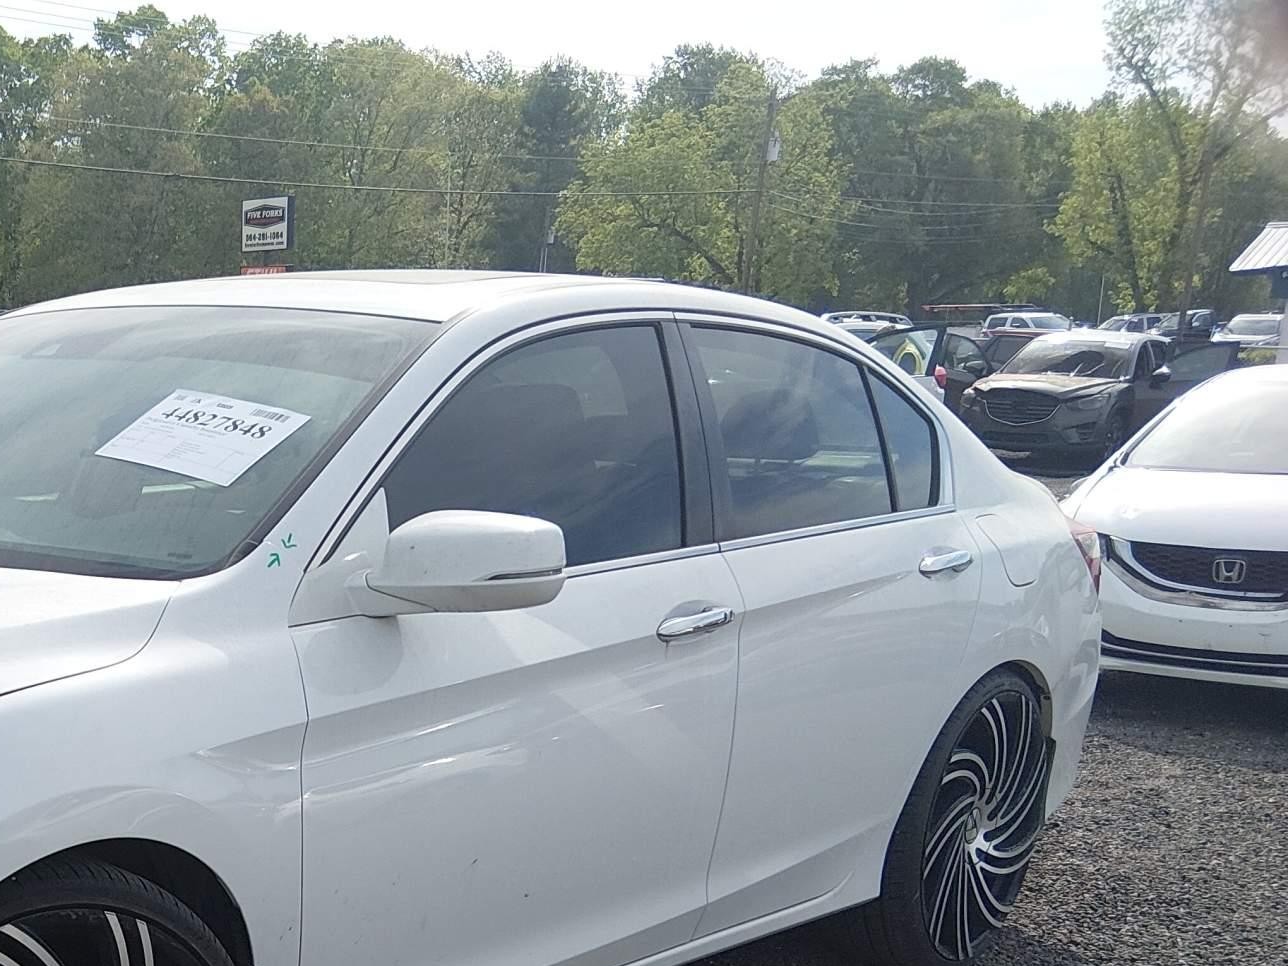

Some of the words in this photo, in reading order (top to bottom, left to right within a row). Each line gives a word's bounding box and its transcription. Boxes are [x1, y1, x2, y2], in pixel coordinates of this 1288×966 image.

[247, 211, 261, 219] FIVE
[262, 208, 283, 218] FORKS
[162, 406, 272, 440] 44827848
